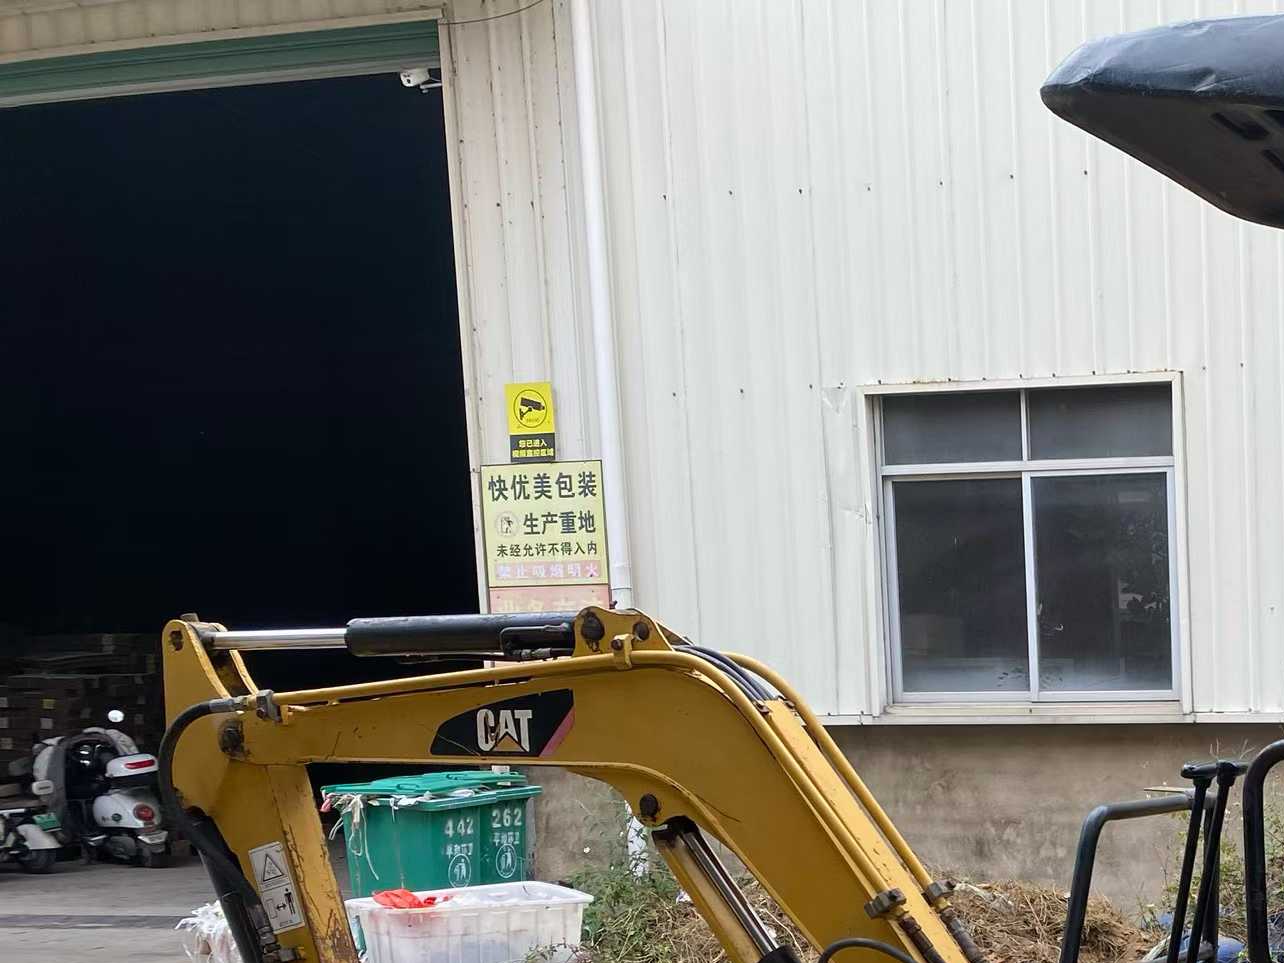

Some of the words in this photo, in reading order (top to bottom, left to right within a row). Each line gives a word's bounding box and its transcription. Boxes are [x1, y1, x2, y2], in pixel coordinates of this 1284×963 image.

[488, 471, 597, 502] 快优美包装
[523, 510, 596, 535] 生产重地
[496, 541, 597, 557] 未经允许不得入内
[476, 708, 533, 752] CAT
[444, 817, 474, 838] 442
[491, 808, 522, 828] 262
